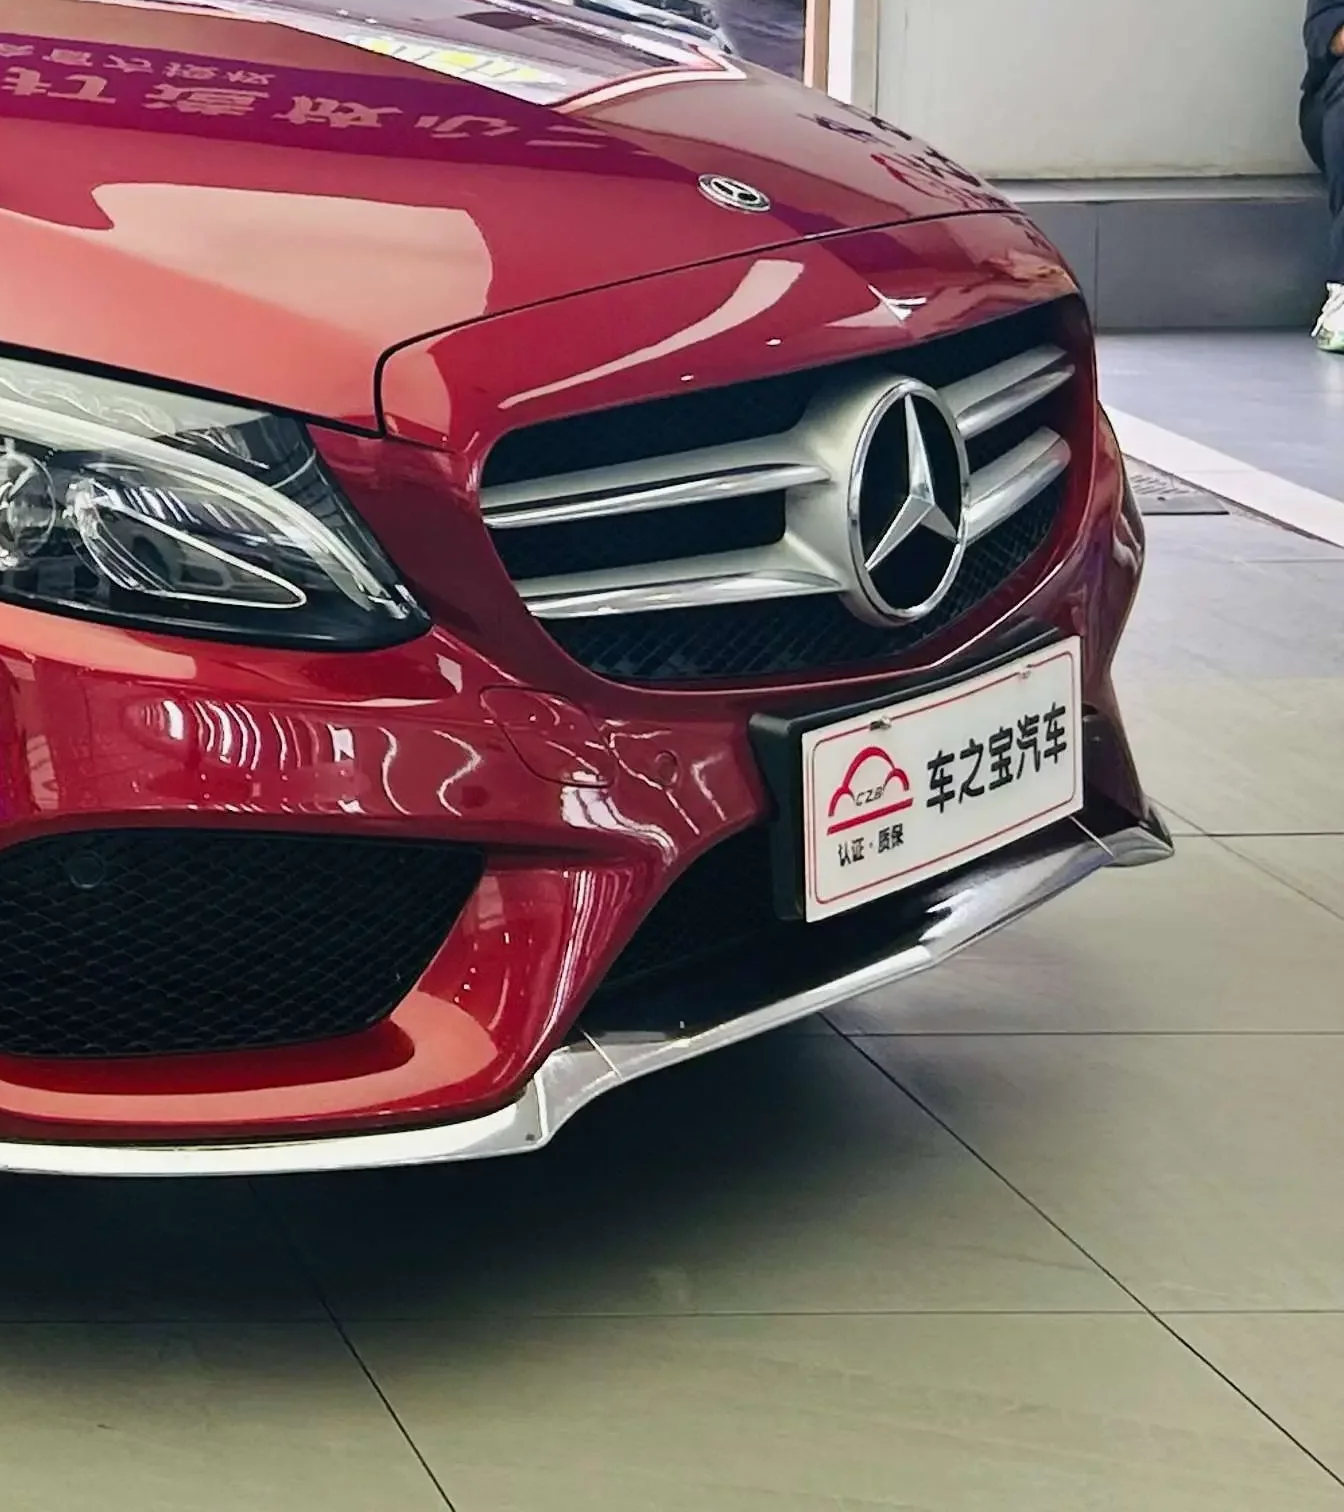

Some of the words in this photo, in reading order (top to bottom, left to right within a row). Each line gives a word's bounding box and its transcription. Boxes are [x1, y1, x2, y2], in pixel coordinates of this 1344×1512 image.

[925, 701, 1068, 814] 车之宝汽车
[855, 782, 885, 807] CZB
